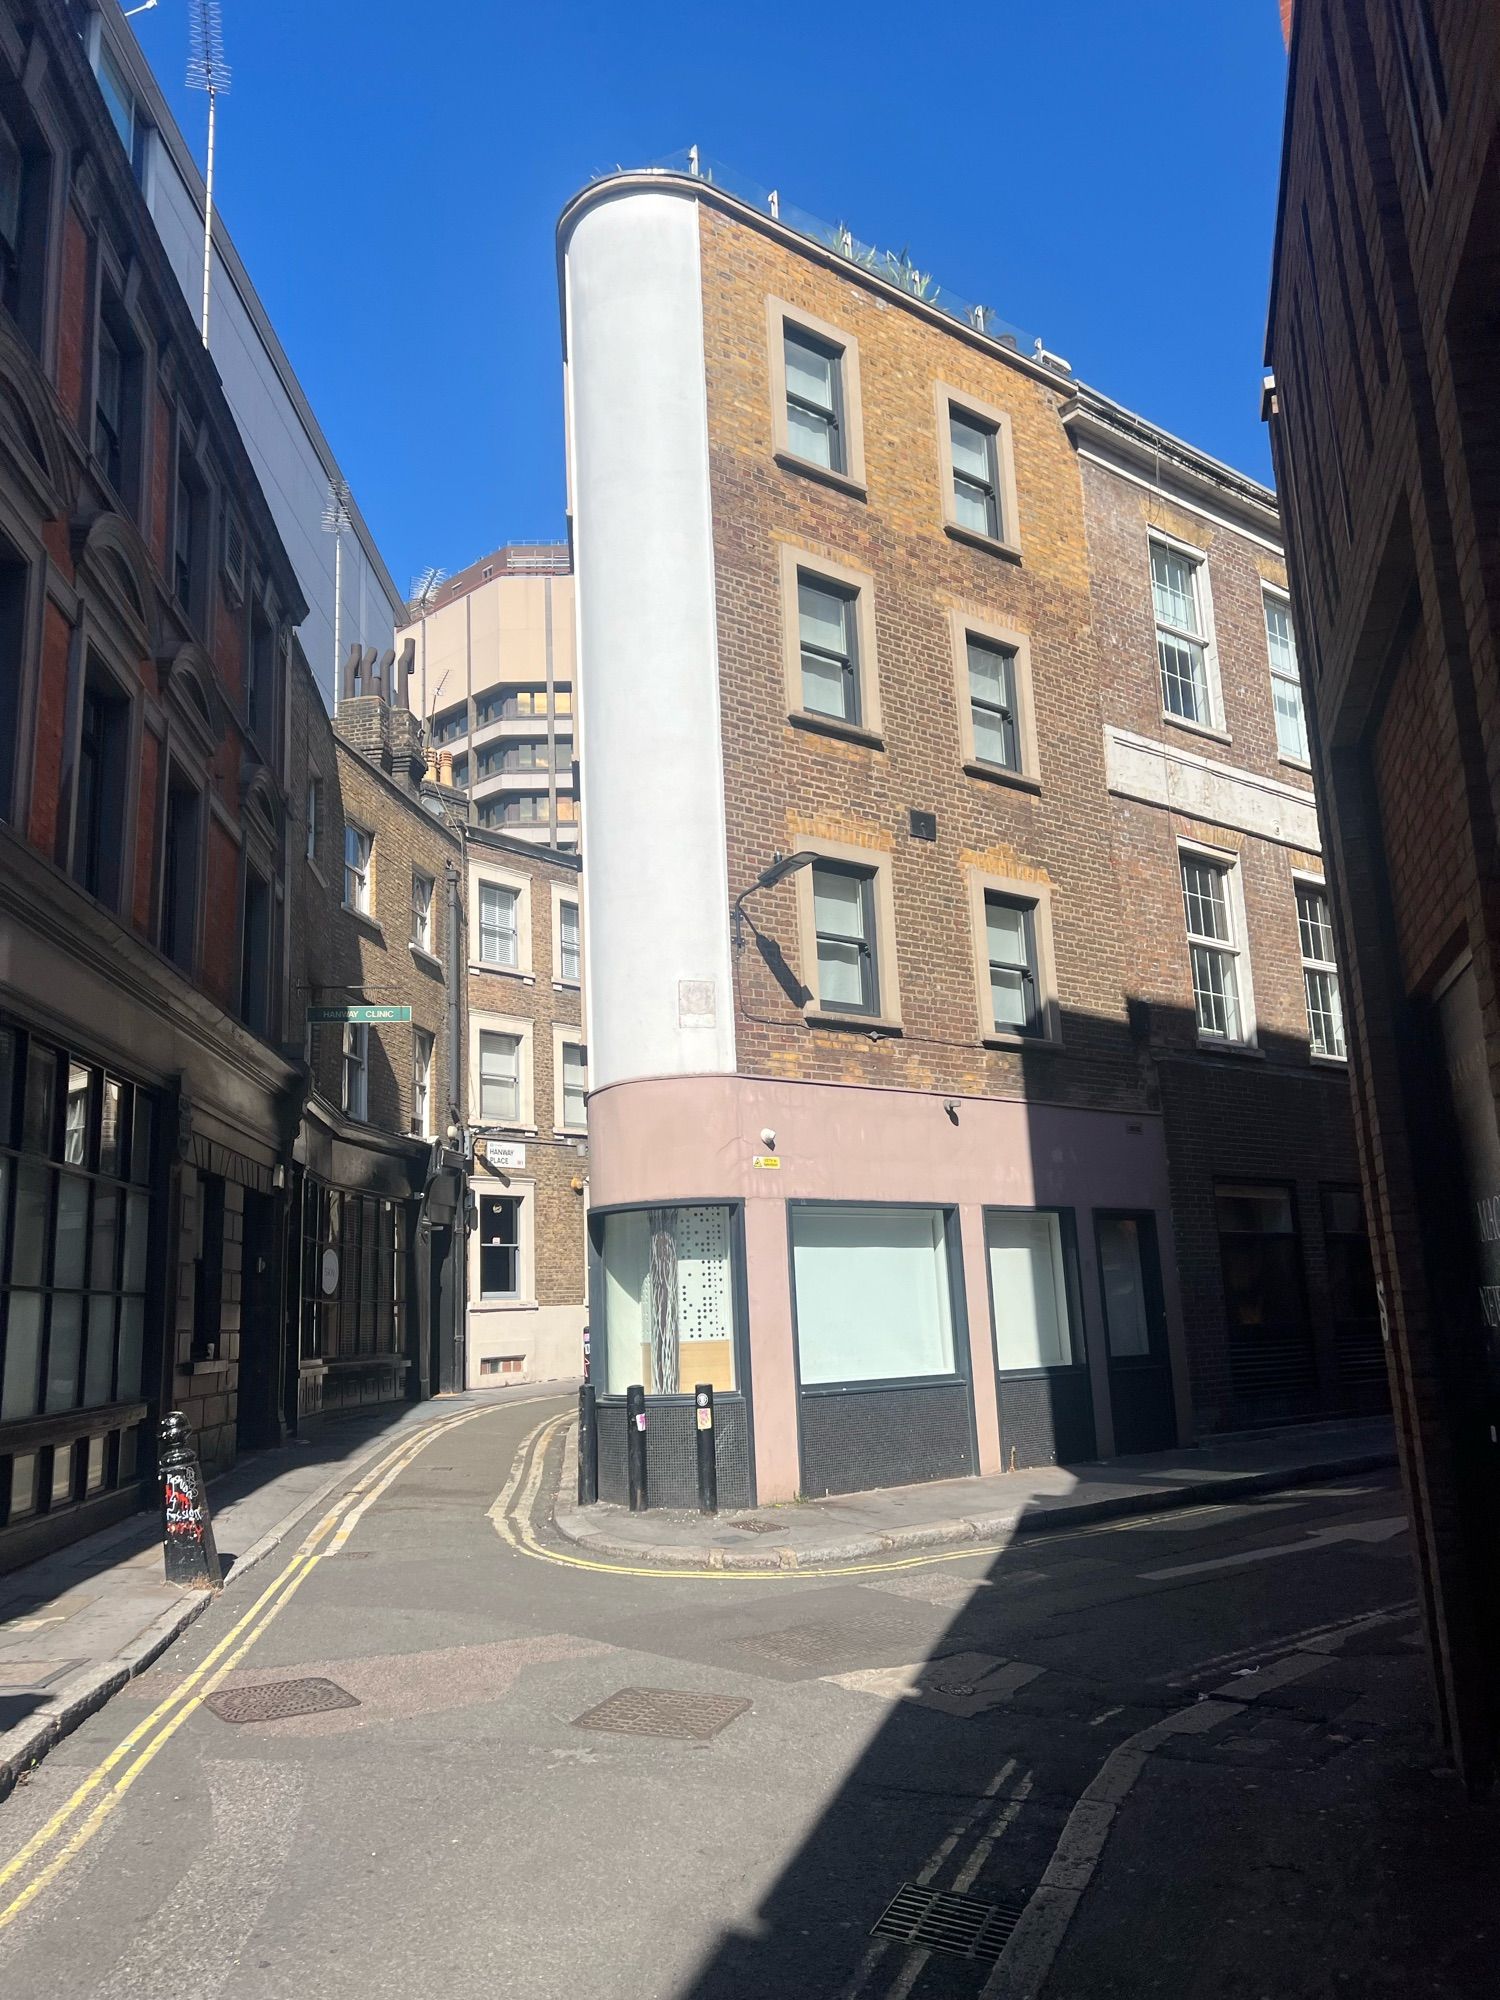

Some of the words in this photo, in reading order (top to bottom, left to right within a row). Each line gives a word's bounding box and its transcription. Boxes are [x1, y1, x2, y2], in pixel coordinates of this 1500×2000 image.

[365, 1010, 394, 1018] CLINIC
[489, 1148, 514, 1156] HANWAY
[489, 1156, 509, 1165] PLACE
